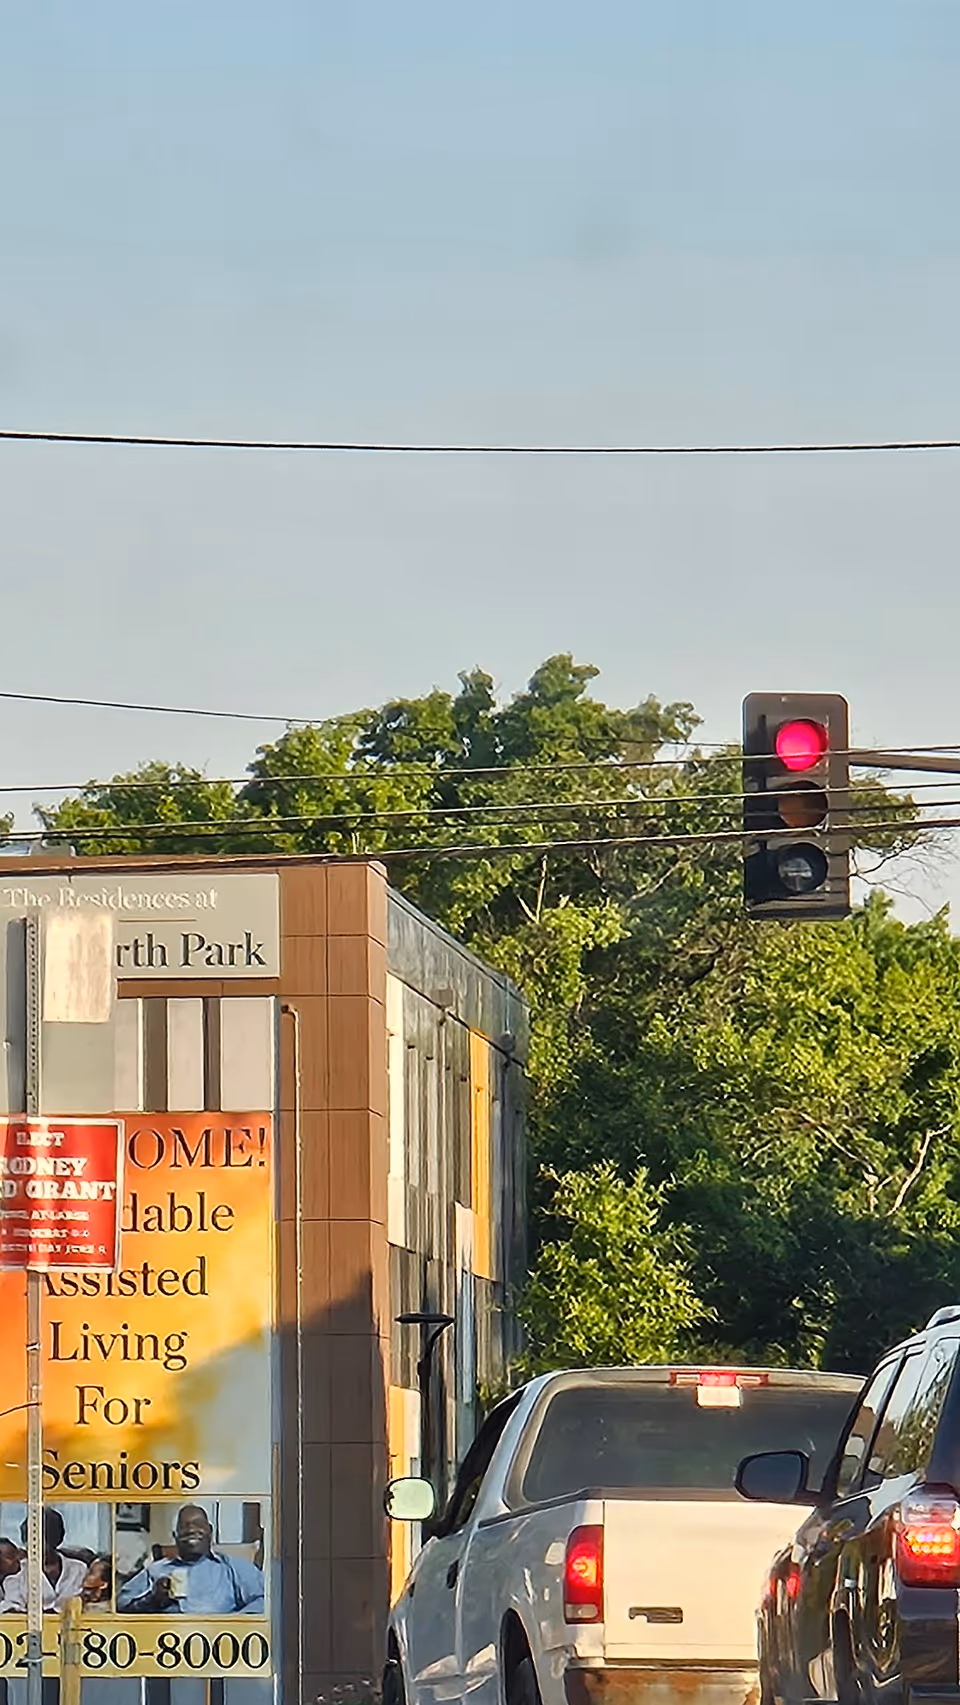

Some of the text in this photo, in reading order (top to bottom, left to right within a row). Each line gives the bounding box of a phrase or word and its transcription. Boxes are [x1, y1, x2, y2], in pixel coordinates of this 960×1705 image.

[3, 886, 218, 910] The Residences at
[180, 931, 267, 968] Park
[128, 1127, 267, 1170] OME!
[25, 1180, 117, 1200] GRANT
[49, 1321, 188, 1371] Living
[74, 1385, 151, 1426] For
[41, 1450, 200, 1490] Seniors
